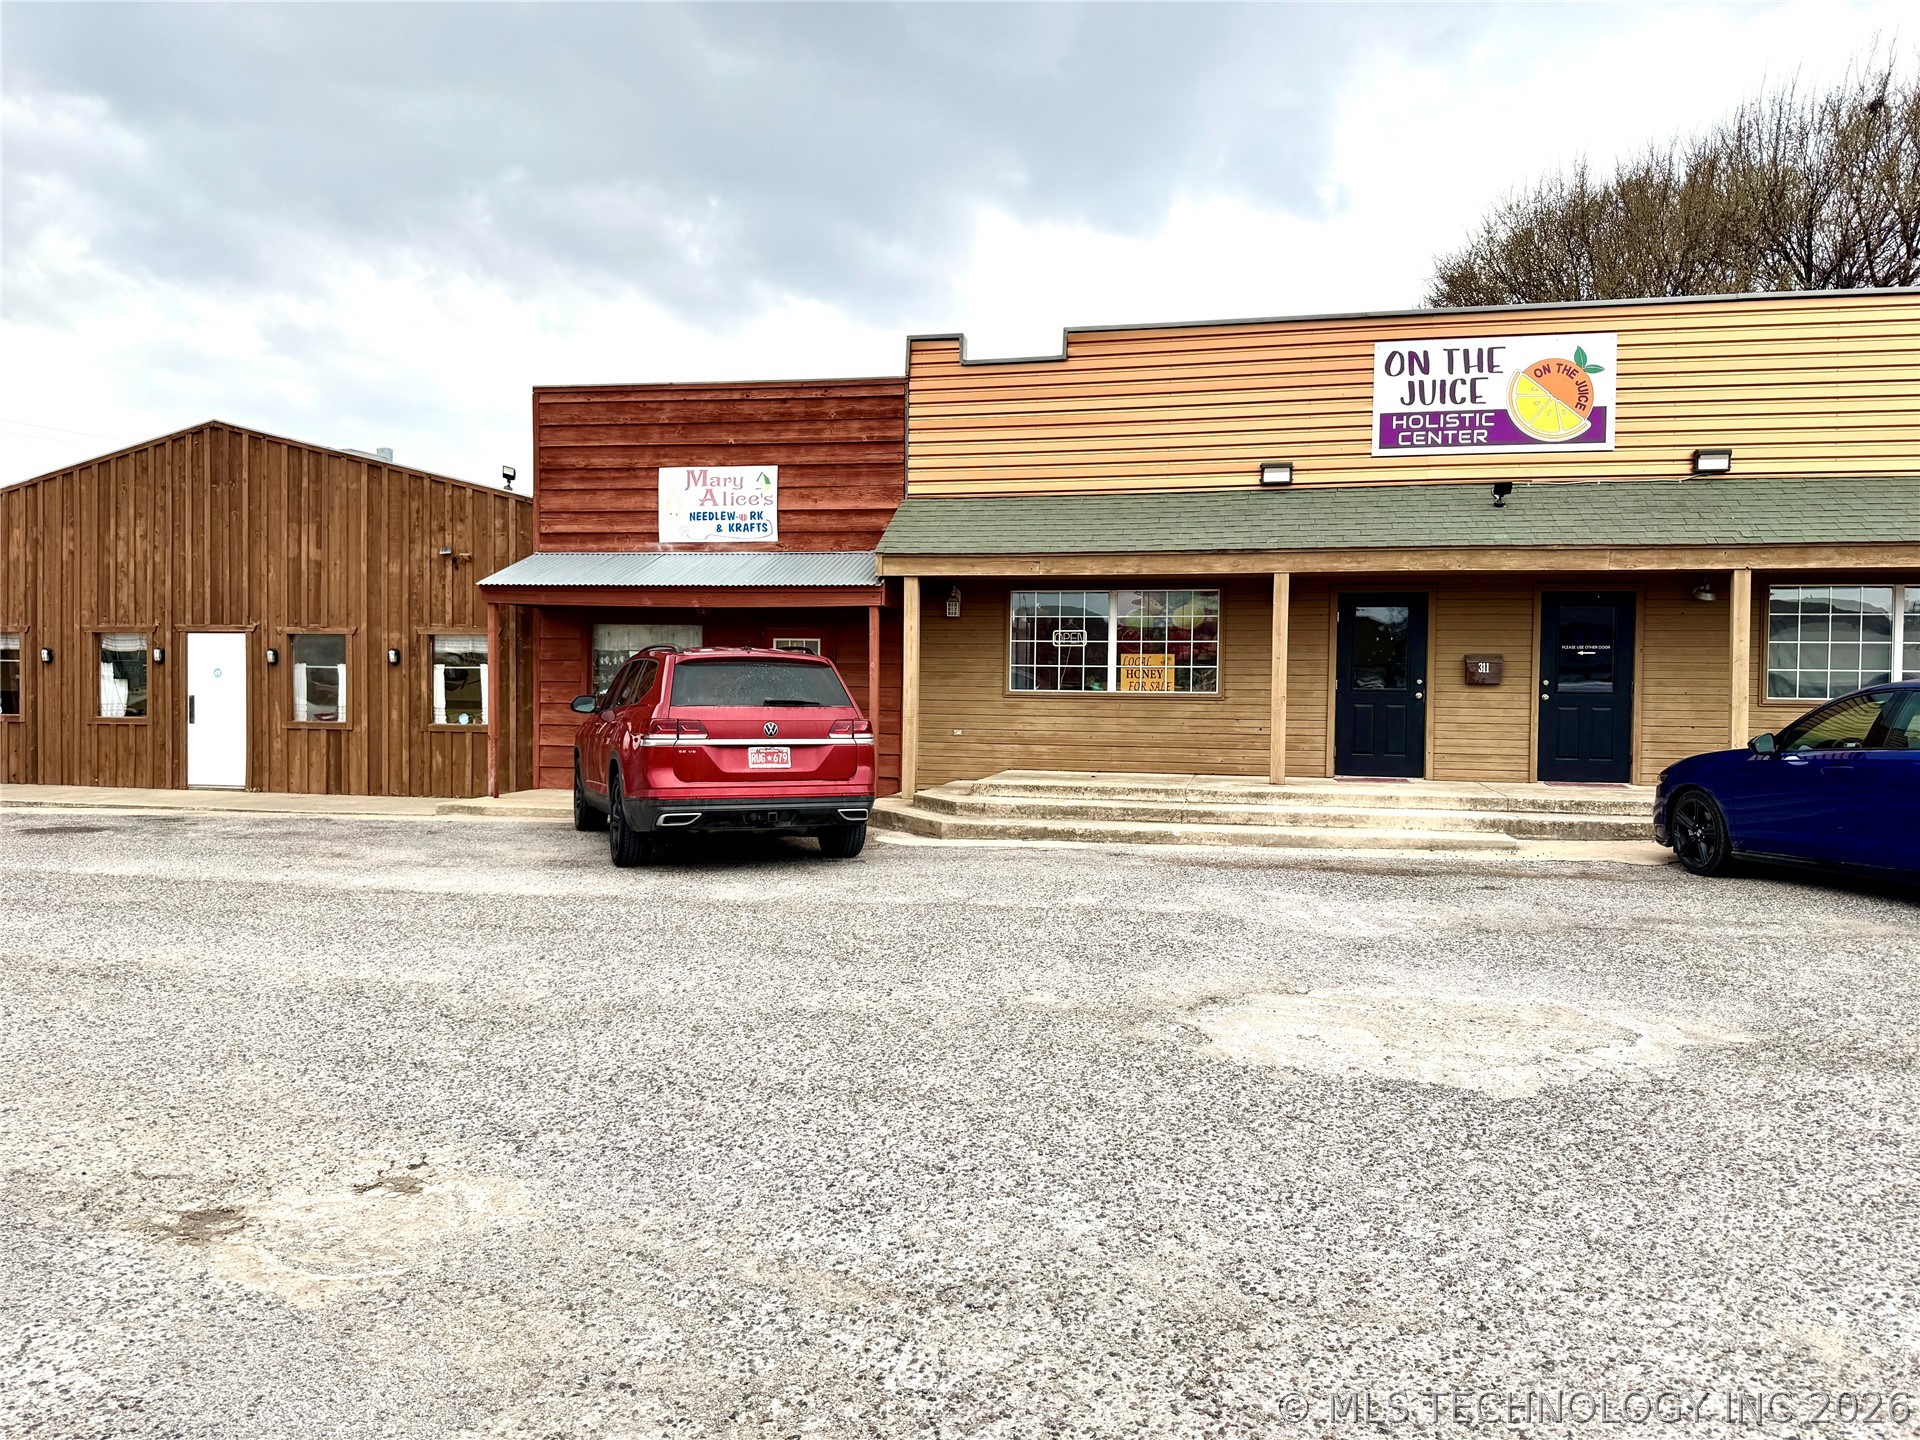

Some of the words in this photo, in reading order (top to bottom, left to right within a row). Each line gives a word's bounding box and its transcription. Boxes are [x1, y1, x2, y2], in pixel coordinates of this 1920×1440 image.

[1384, 350, 1430, 377] ON
[1443, 346, 1506, 375] THE
[1400, 377, 1489, 406] JUICE
[1533, 363, 1551, 378] ON
[1556, 363, 1579, 380] THE
[1575, 380, 1589, 411] JUICE
[1392, 412, 1495, 430] HOLISTIC
[1398, 429, 1488, 446] CENTER
[684, 469, 744, 491] Mary
[699, 488, 774, 507] Alice's
[716, 524, 723, 532] &
[728, 523, 768, 532] KRAFTS
[1055, 632, 1084, 645] OPEN
[1123, 656, 1151, 666] LOCAL
[1478, 662, 1490, 673] 311
[1126, 669, 1163, 679] HONEY
[1129, 681, 1147, 691] FOR
[1150, 681, 1172, 691] SALE
